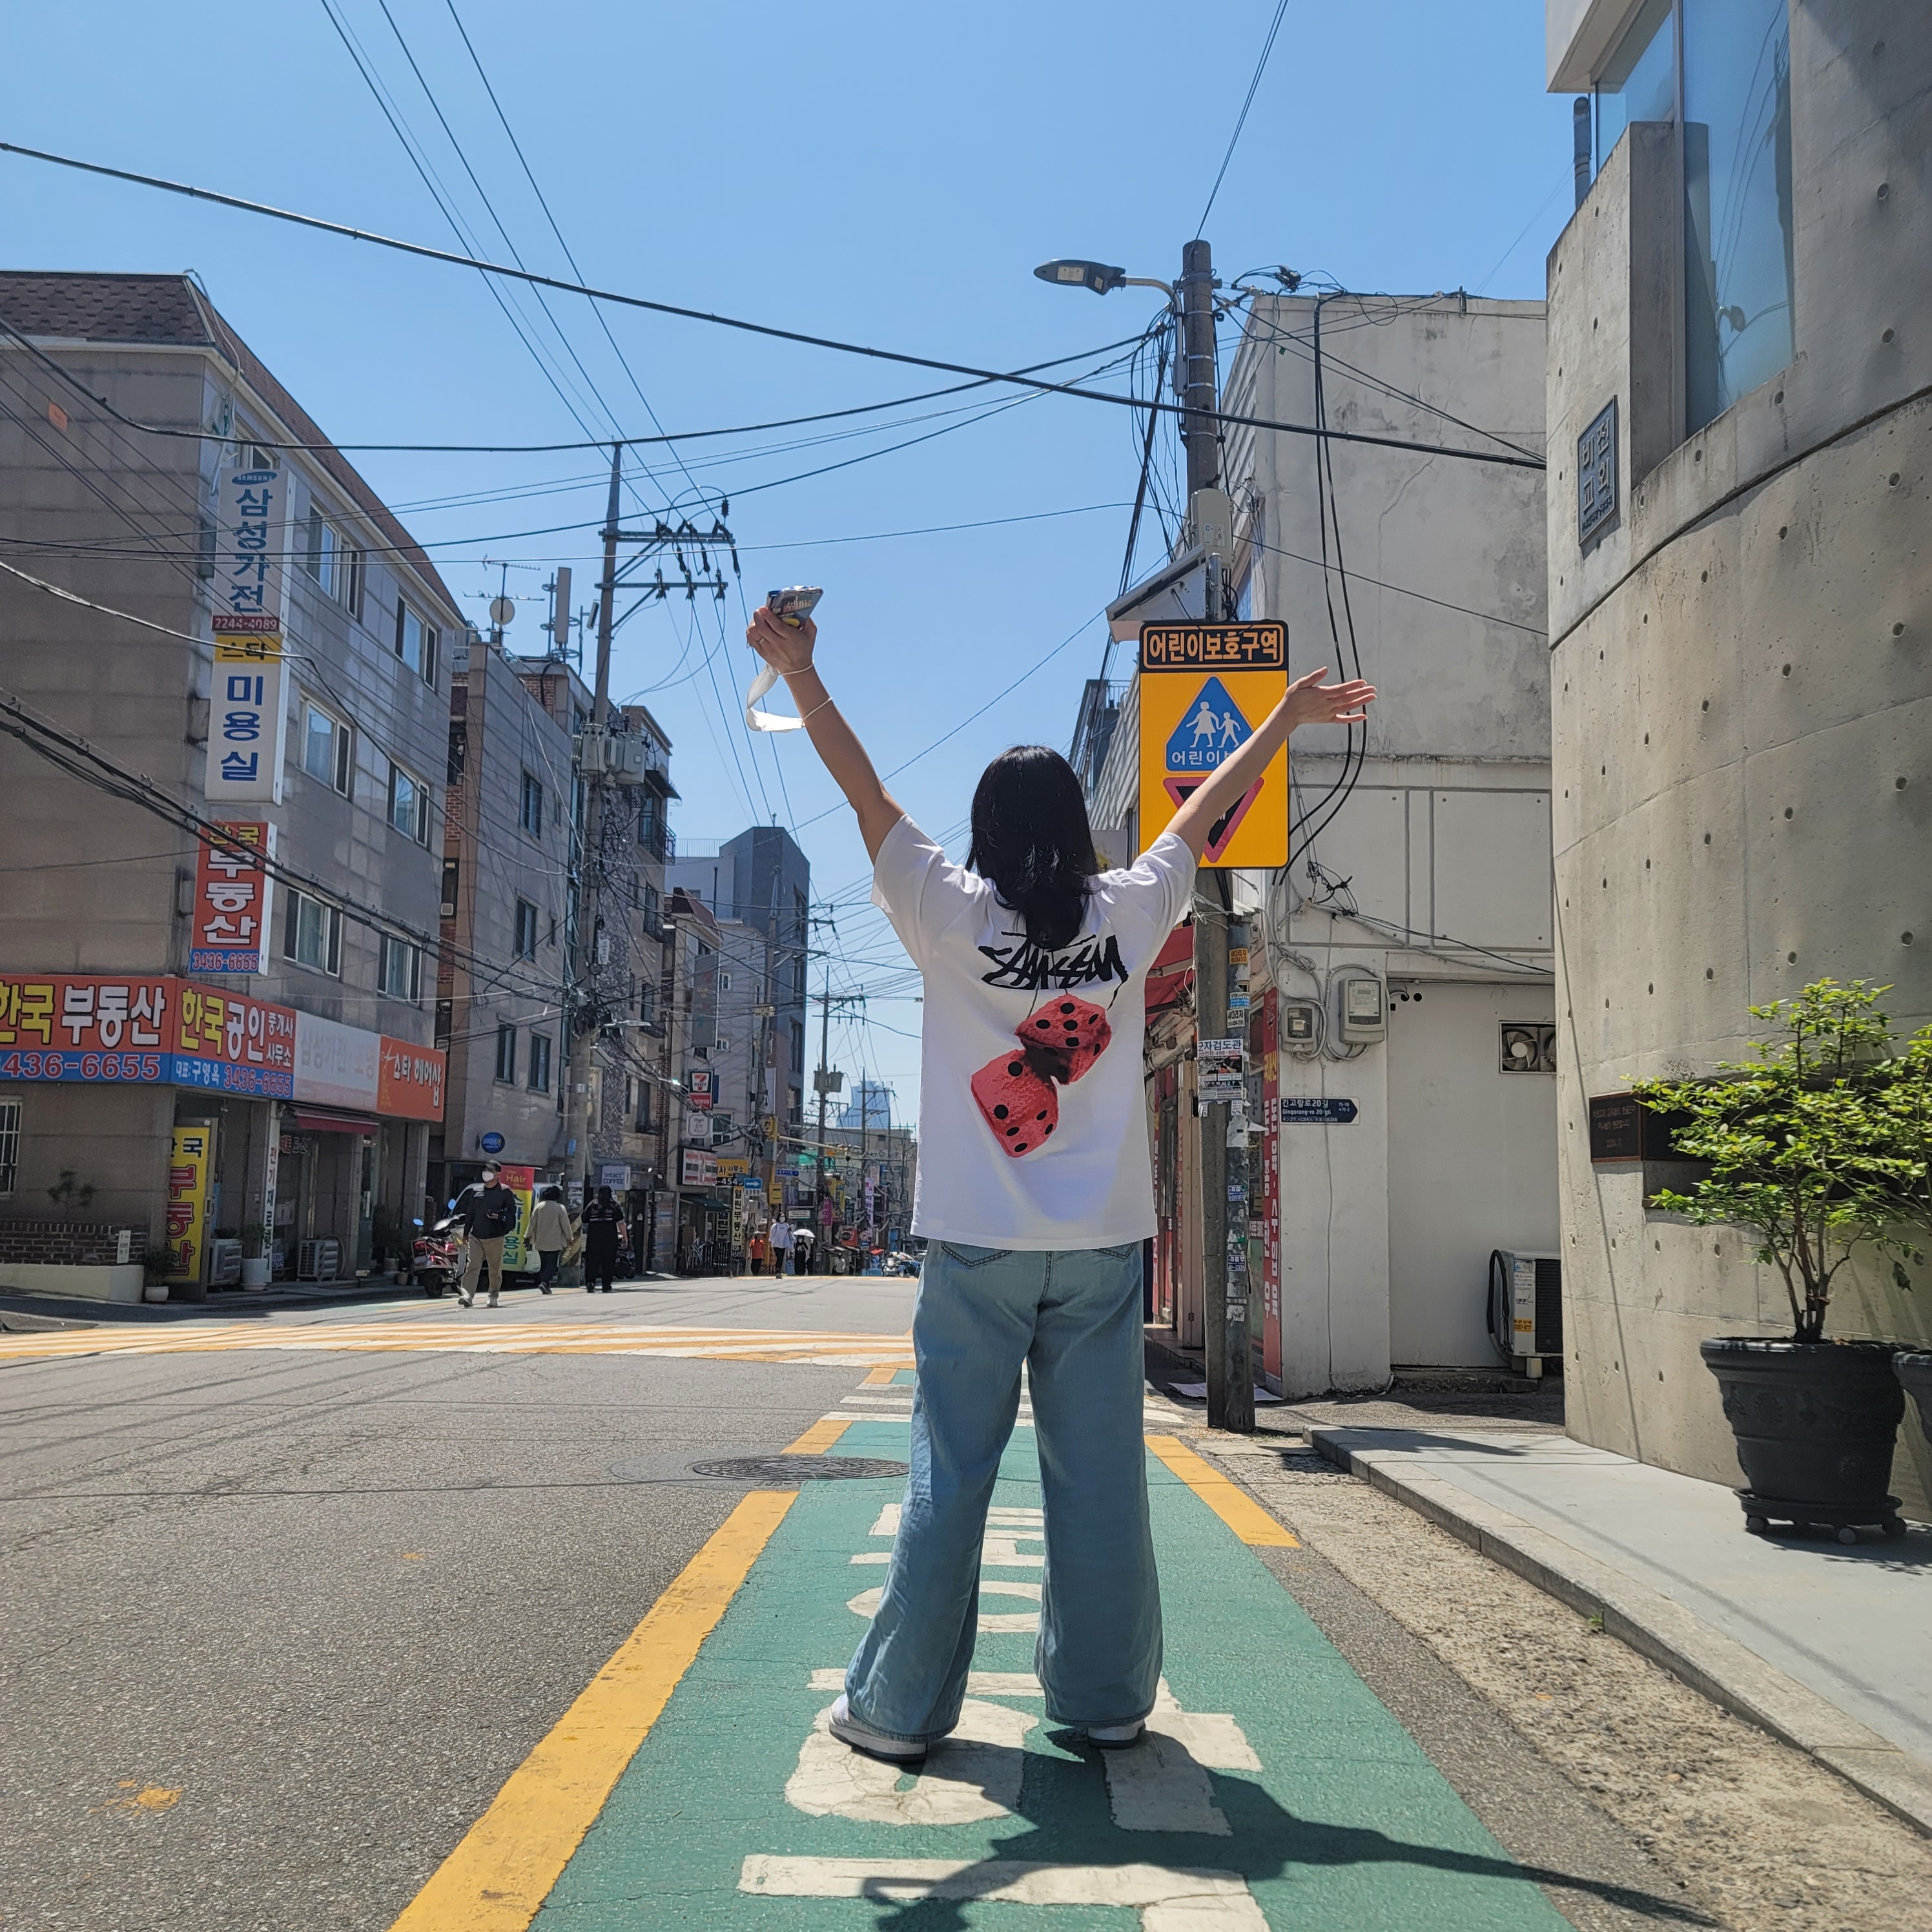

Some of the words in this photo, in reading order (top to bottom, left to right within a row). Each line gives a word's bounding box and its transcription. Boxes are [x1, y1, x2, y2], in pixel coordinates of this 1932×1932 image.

[229, 488, 274, 613] 삼성가전
[214, 617, 278, 631] 2244-4089
[1149, 630, 1278, 662] 어린이보호구역
[220, 675, 263, 782] 미용실
[1171, 750, 1236, 766] 어린이
[202, 848, 258, 945] 부동산
[192, 951, 259, 971] 3436-6655
[0, 981, 55, 1045] 한국
[61, 985, 166, 1049] 부동산
[267, 1011, 294, 1040] 중개사
[265, 1042, 292, 1069] 사무소
[1198, 1039, 1242, 1052] 군자검도관
[0, 1052, 161, 1081] 436-6655
[393, 1053, 412, 1083] 스타
[414, 1056, 442, 1107] 헤어샵
[223, 1065, 292, 1098] 3436-6655
[1282, 1099, 1329, 1108] 긴고랑로20길
[506, 1173, 526, 1183] Hair
[733, 1189, 743, 1242] 열린부동산
